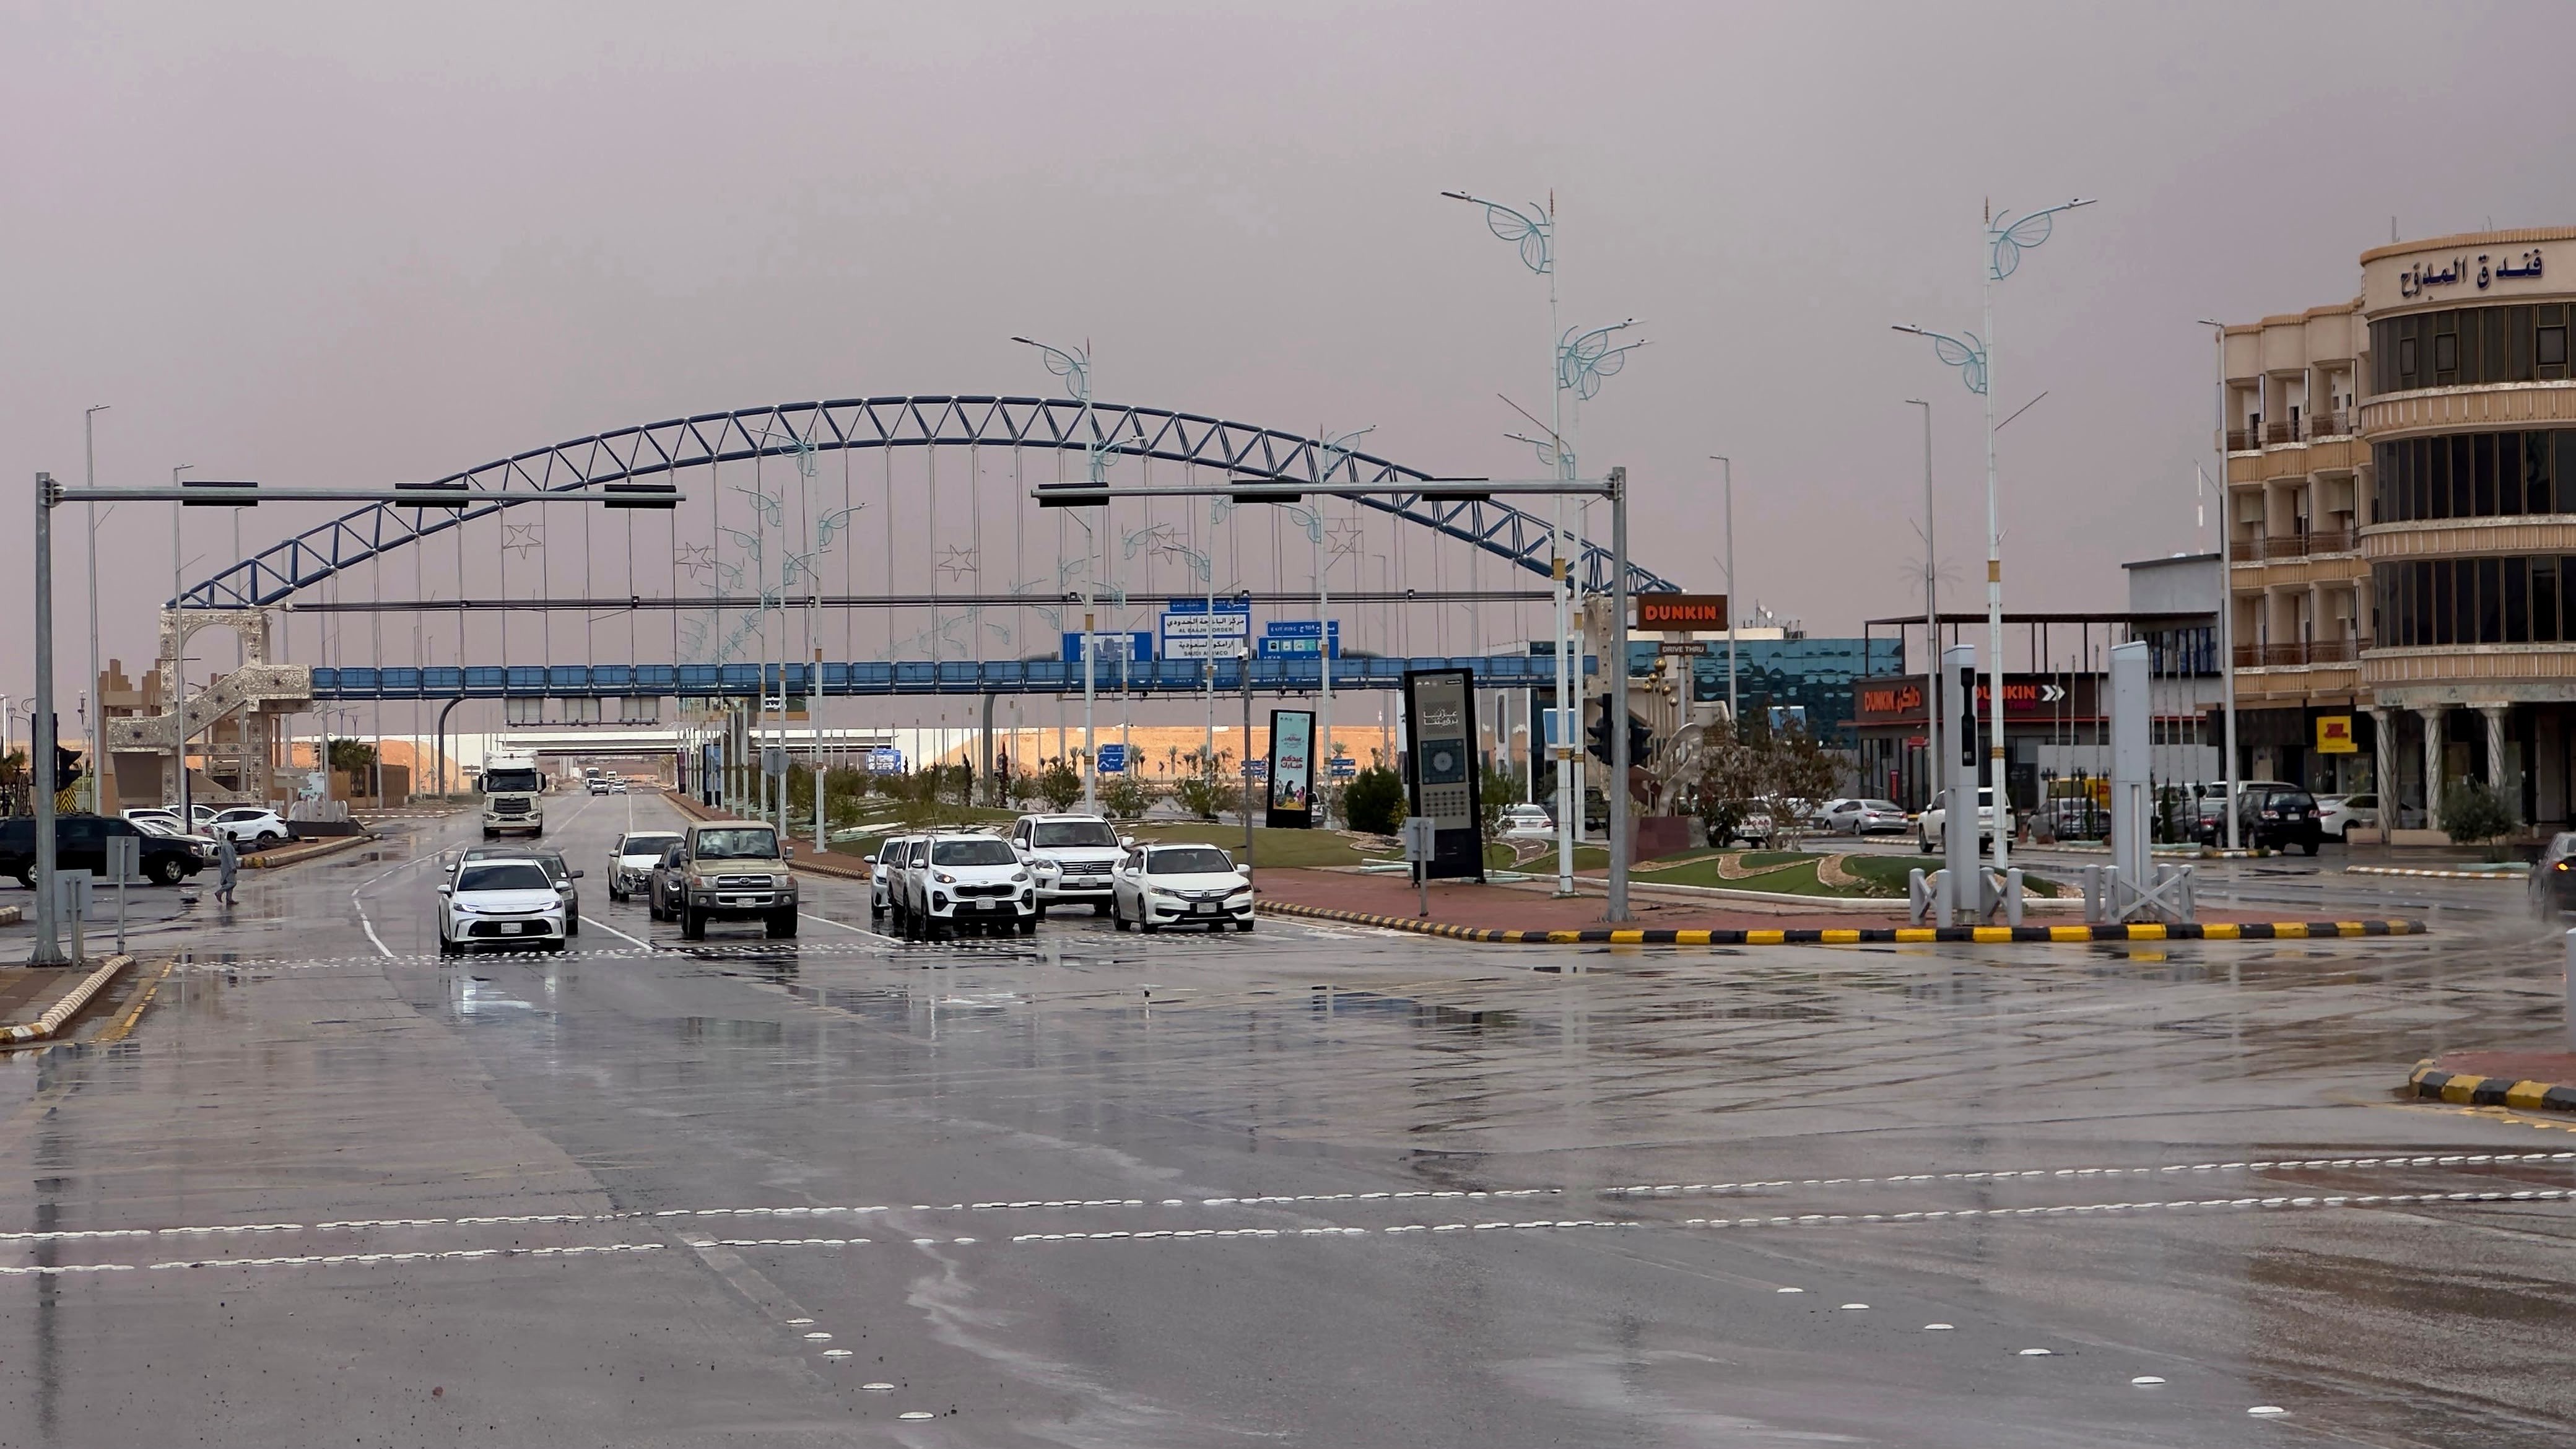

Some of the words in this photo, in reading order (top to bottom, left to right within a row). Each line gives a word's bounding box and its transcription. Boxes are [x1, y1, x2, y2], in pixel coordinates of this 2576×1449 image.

[2477, 249, 2544, 289] فندق
[1645, 605, 1717, 620] DUNKIN
[1167, 617, 1197, 627] الحدودي
[1229, 617, 1244, 625] مركز
[1178, 641, 1208, 649] لسعودية
[1977, 685, 2035, 700] DUKIN
[1865, 690, 1894, 712] DUNKIN
